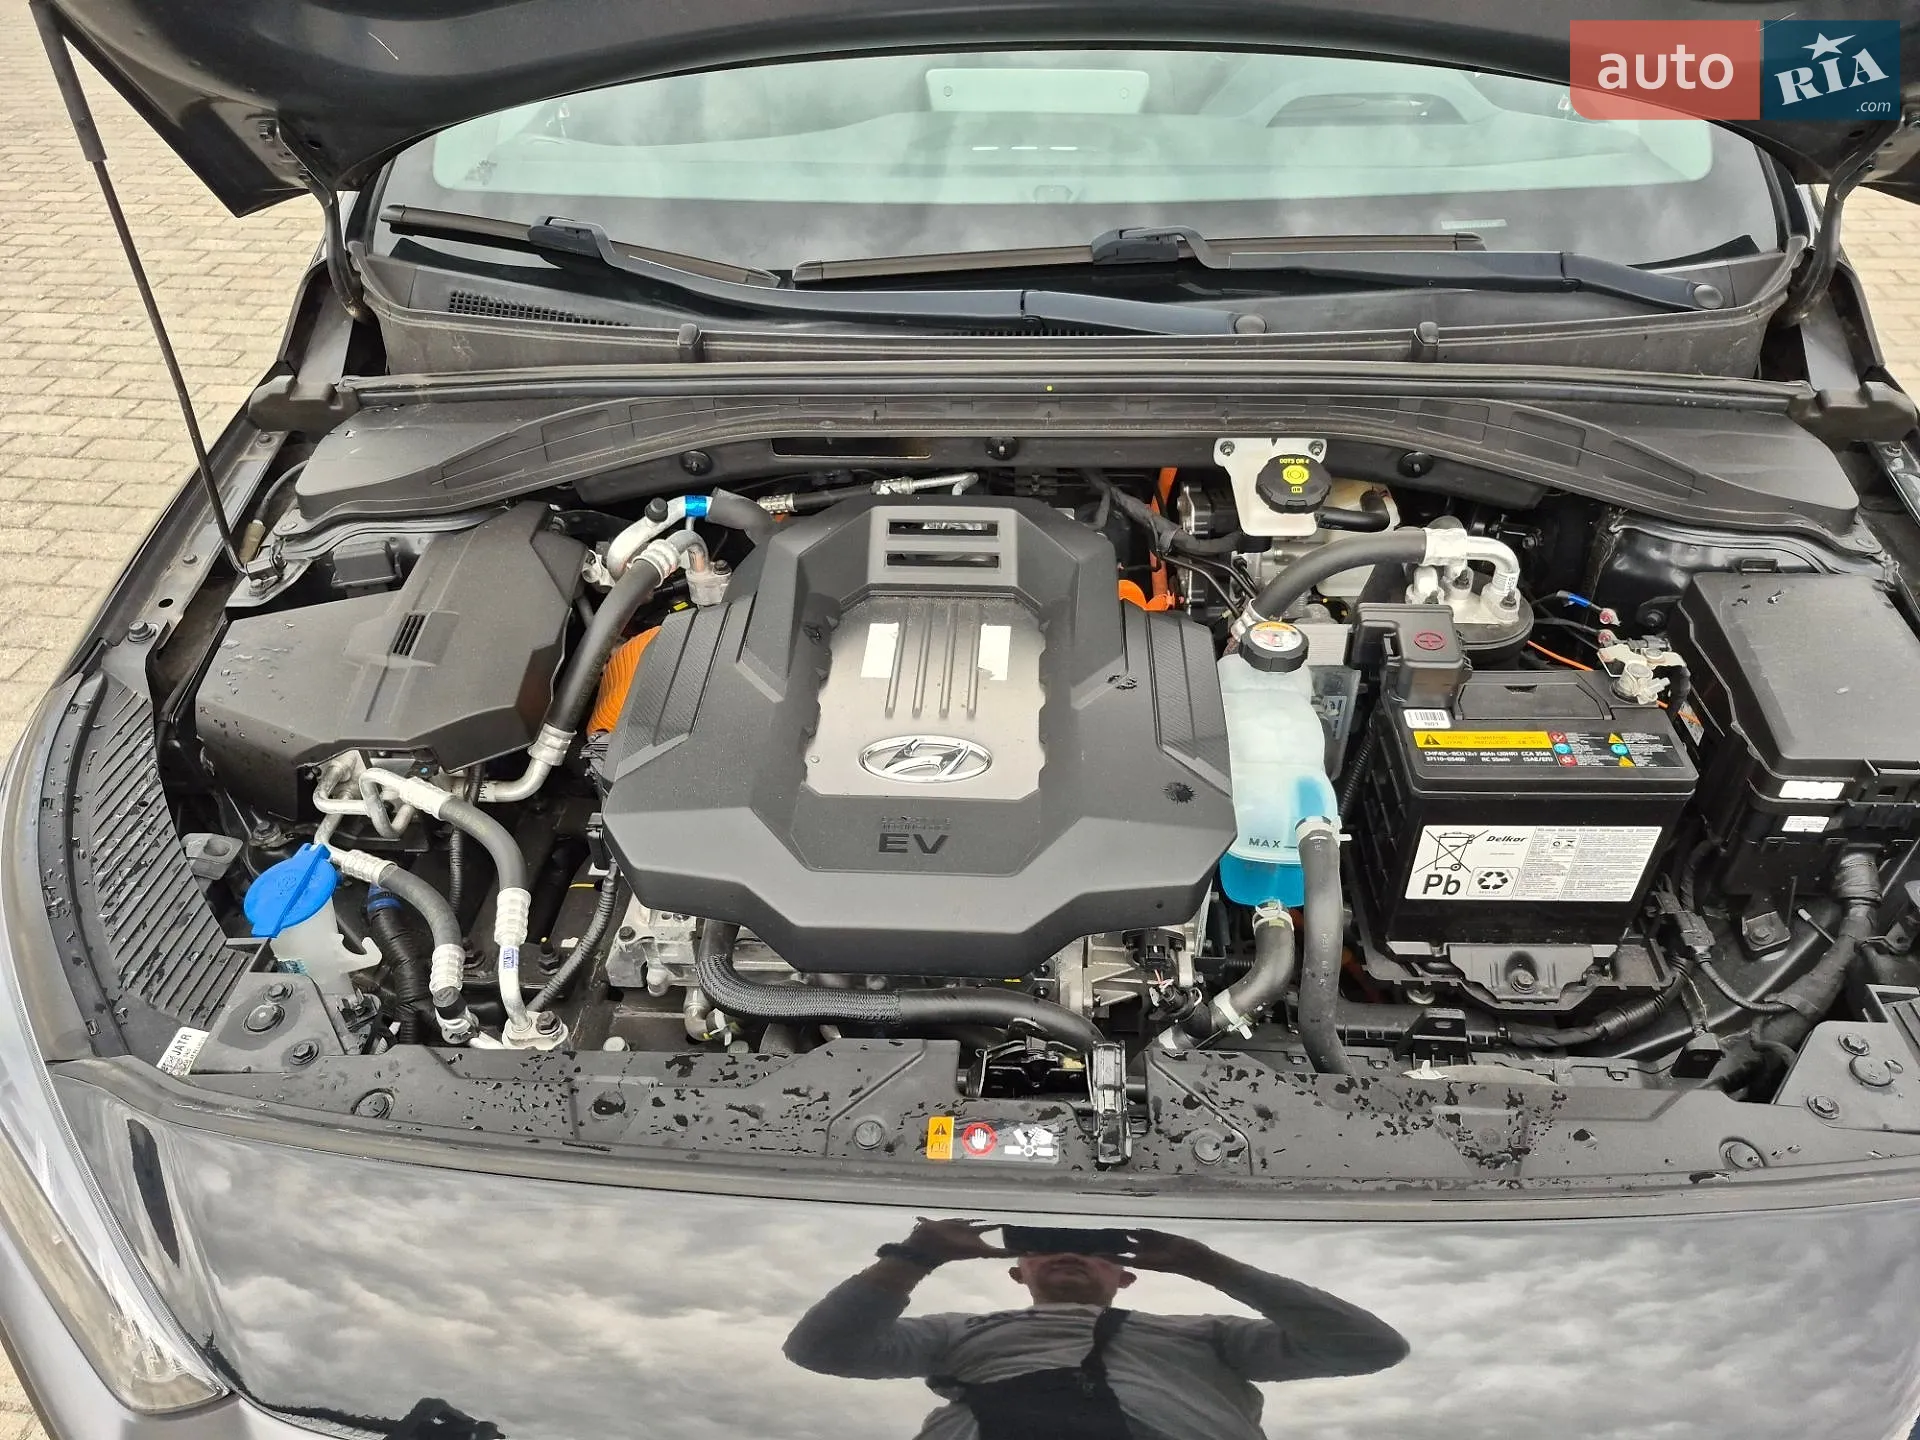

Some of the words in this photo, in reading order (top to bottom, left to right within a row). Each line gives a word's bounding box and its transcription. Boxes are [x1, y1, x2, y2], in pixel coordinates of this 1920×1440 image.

[878, 833, 949, 854] EV
[1248, 837, 1281, 848] MAX
[1485, 835, 1528, 843] Delkor
[1422, 873, 1461, 896] Pb
[171, 1034, 192, 1055] JATR
